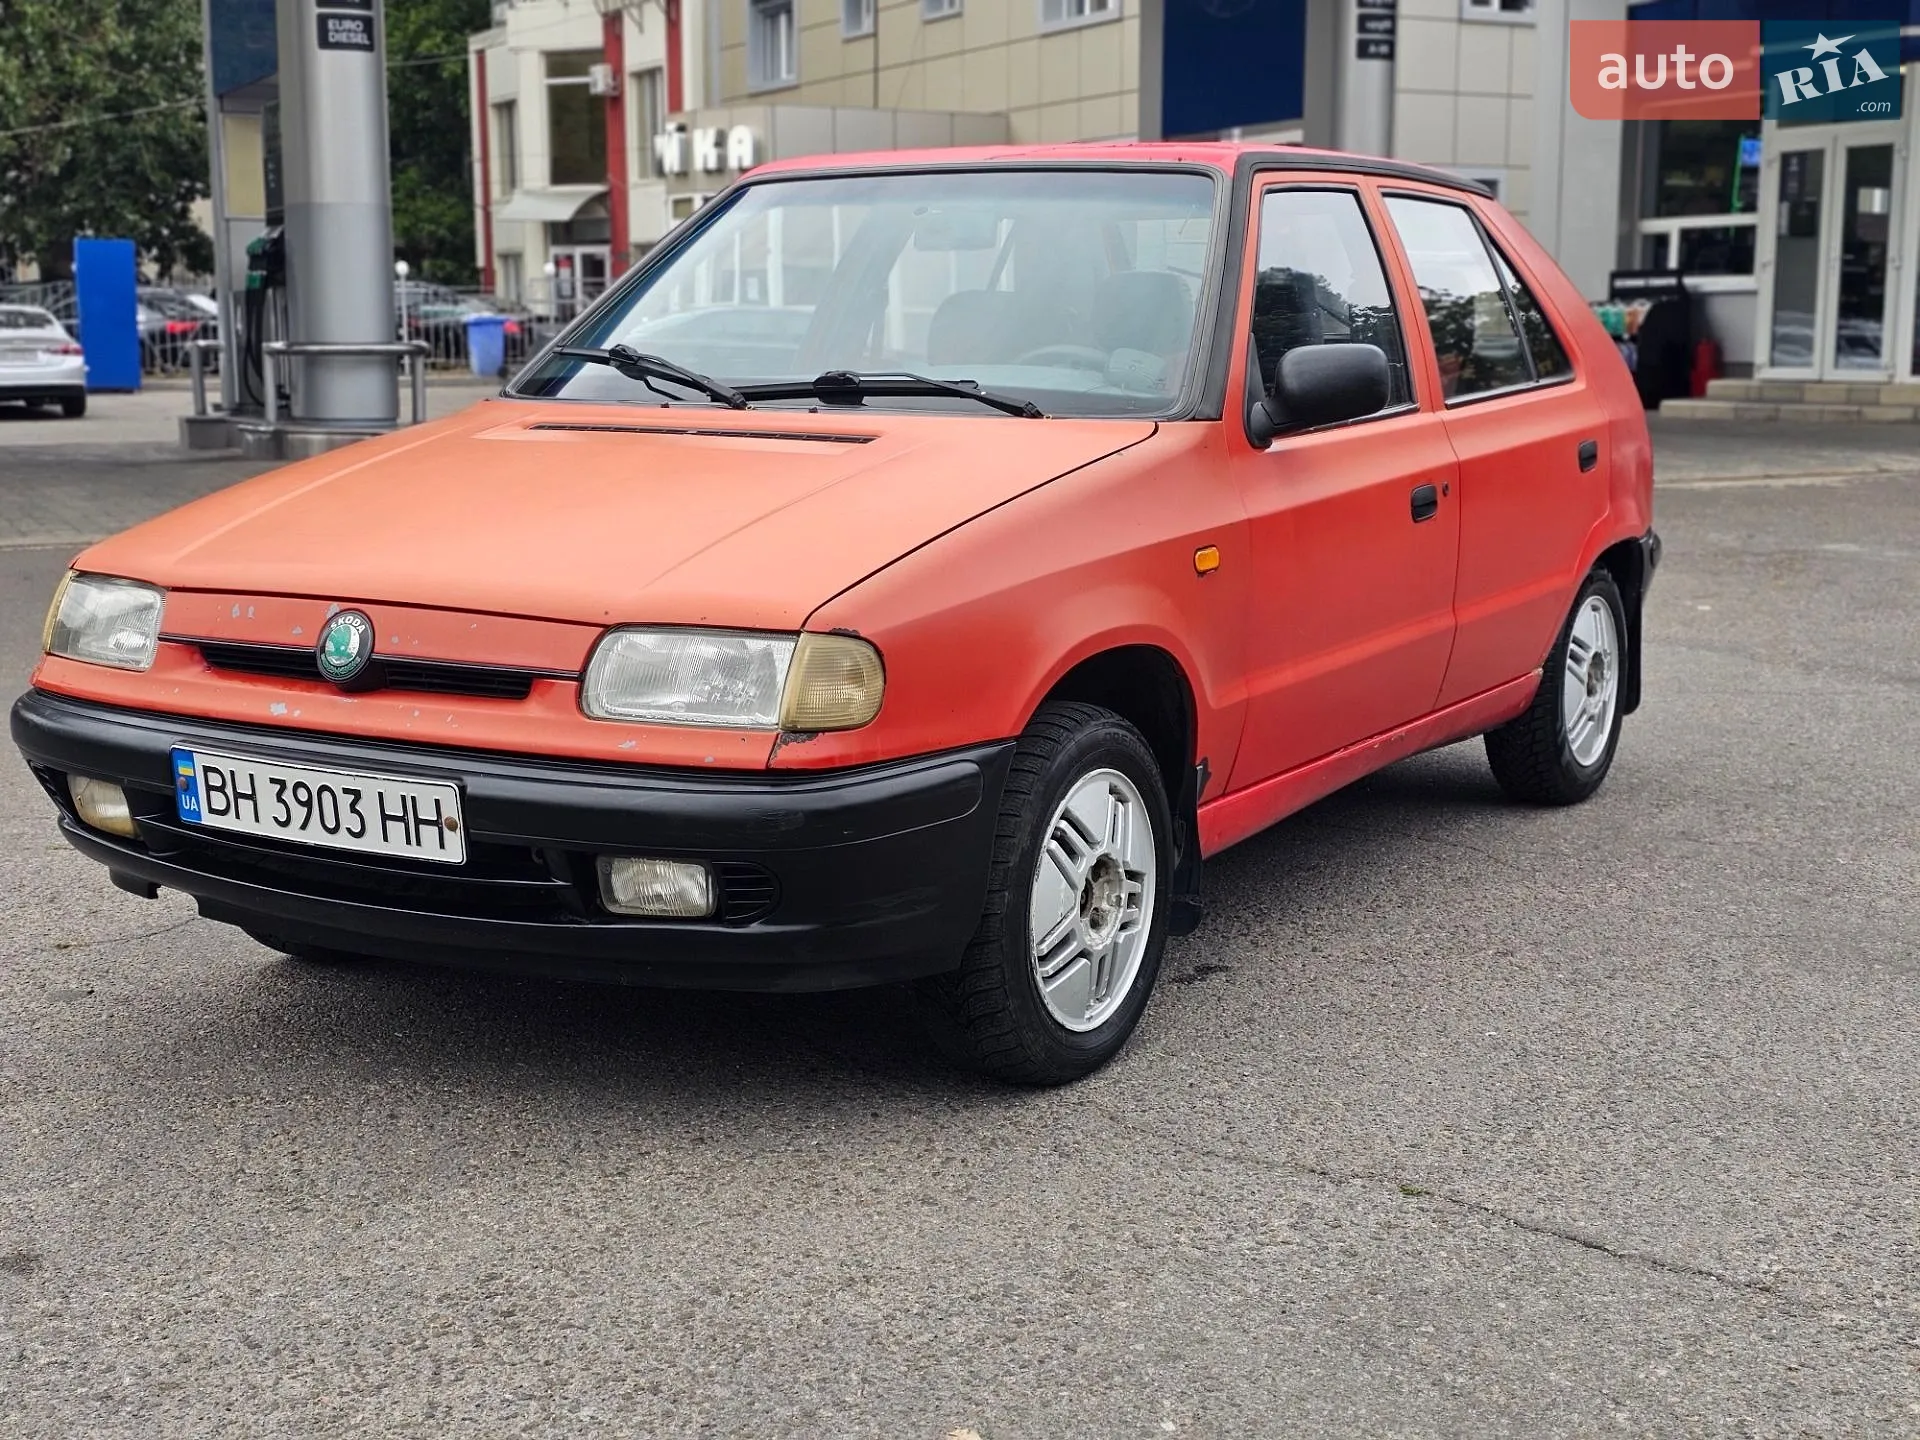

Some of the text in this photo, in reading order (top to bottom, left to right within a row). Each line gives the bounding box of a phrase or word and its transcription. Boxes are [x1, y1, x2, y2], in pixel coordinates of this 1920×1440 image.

[328, 18, 364, 31] EURO
[328, 31, 371, 45] DIESEL
[181, 793, 200, 812] UA
[201, 764, 446, 850] BH 3903 HH
